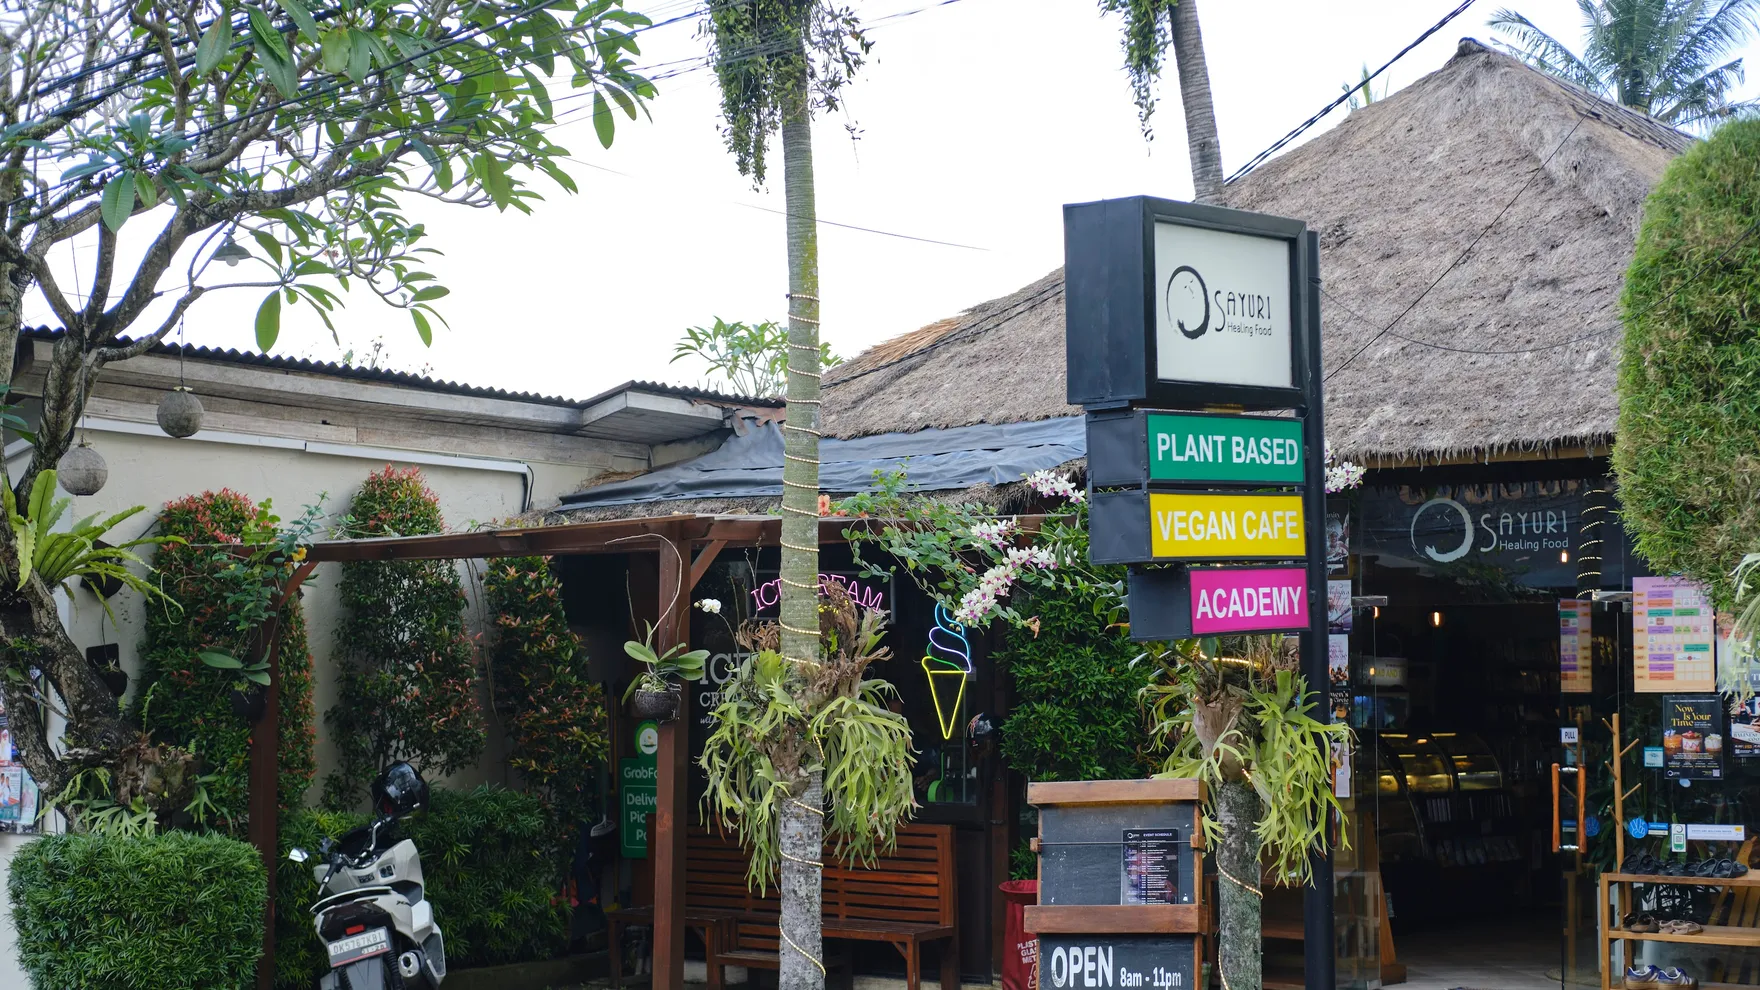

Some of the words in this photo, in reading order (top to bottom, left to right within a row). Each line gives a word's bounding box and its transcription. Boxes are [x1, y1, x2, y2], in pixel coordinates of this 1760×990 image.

[1214, 290, 1271, 332] SAYURI
[1227, 322, 1253, 337] Healing
[1255, 324, 1272, 336] Food
[1156, 432, 1226, 463] PLANT
[1231, 436, 1299, 465] BASED
[1156, 510, 1236, 541] VEGAN
[1242, 510, 1299, 540] CAFE
[1480, 510, 1568, 553] SAYURI
[1500, 539, 1539, 552] Healing
[1543, 537, 1569, 549] Food
[1195, 586, 1302, 619] ACADEMY
[1675, 704, 1694, 713] Now
[1671, 718, 1694, 727] Time
[1683, 712, 1691, 721] Is
[1692, 712, 1712, 721] Your
[1564, 731, 1576, 739] PULL
[623, 766, 658, 779] GrabFo
[626, 793, 657, 805] Deliv
[1051, 945, 1113, 988] OPEN
[1120, 967, 1142, 987] 8am
[1153, 966, 1182, 990] 11pm
